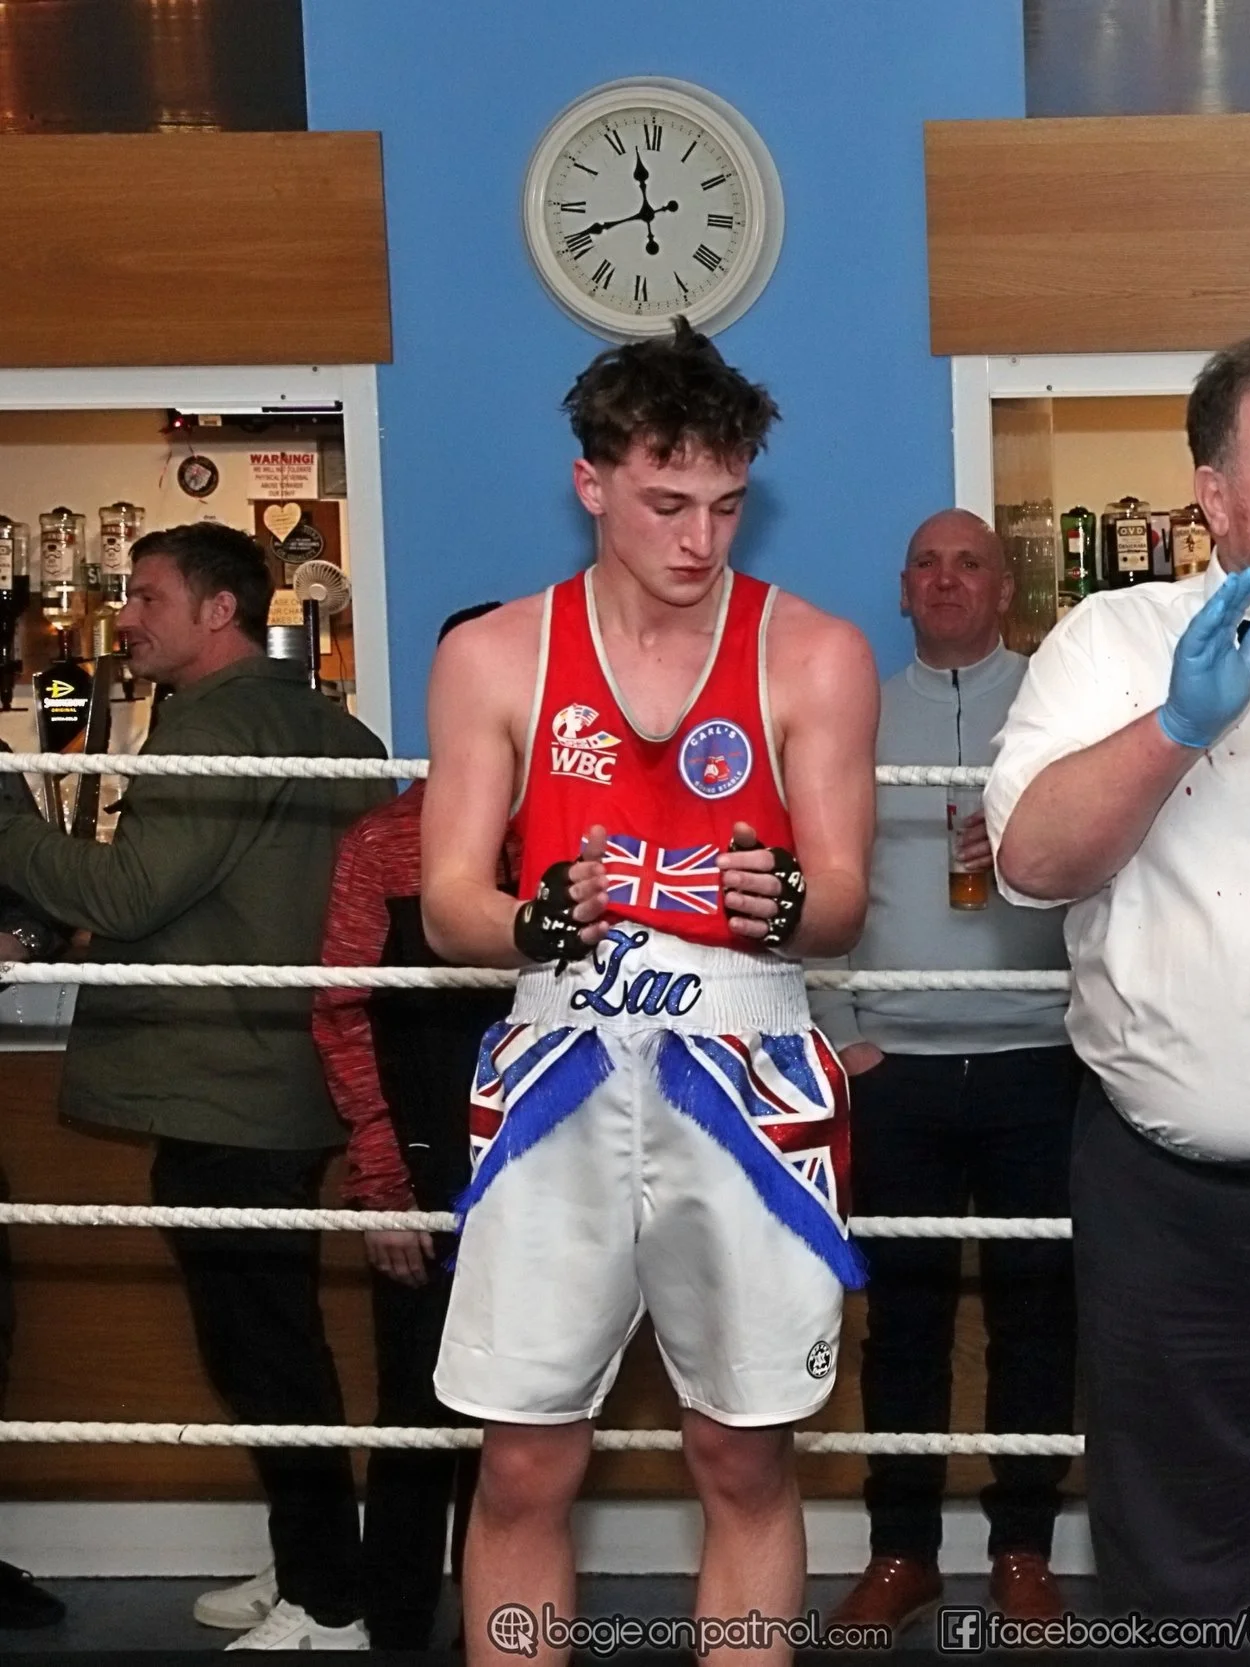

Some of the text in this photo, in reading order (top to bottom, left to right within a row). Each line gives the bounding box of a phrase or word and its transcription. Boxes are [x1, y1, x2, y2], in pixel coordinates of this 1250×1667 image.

[250, 454, 314, 464] WARNING!
[691, 727, 736, 746] CARL'S
[551, 747, 616, 781] WBC
[718, 771, 743, 792] STABLE
